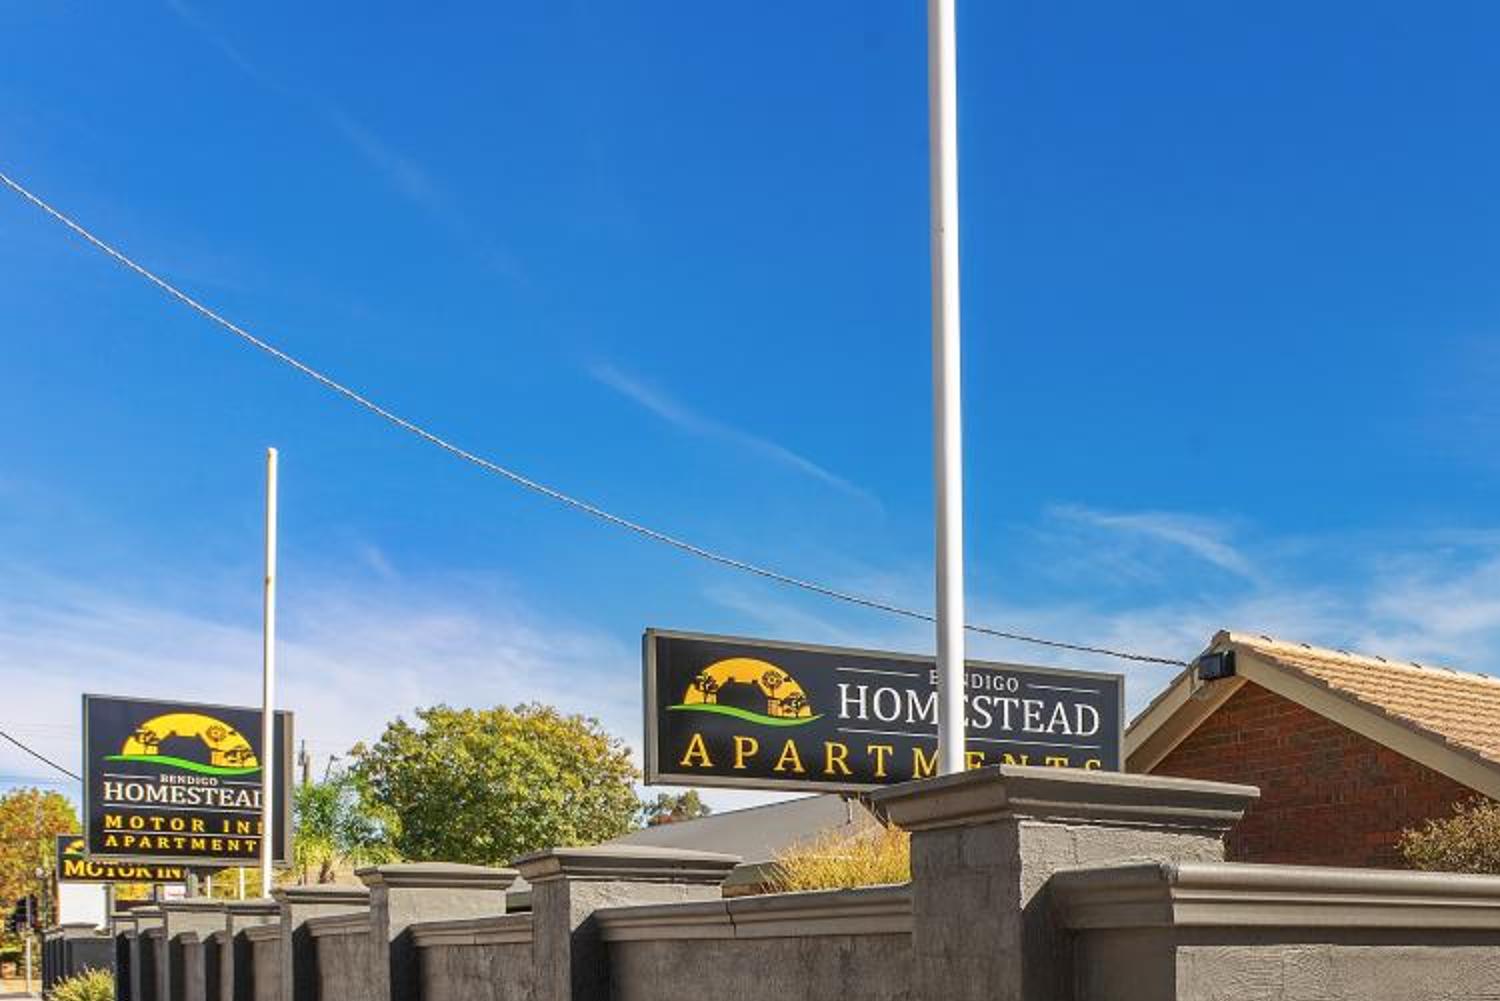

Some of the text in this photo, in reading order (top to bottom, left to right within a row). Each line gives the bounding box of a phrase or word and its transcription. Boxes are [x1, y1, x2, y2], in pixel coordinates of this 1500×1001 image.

[929, 669, 1019, 692] BDIGO
[159, 773, 219, 787] BENDIGO
[104, 814, 263, 835] MOTOR IN
[104, 834, 257, 853] APARTMENT
